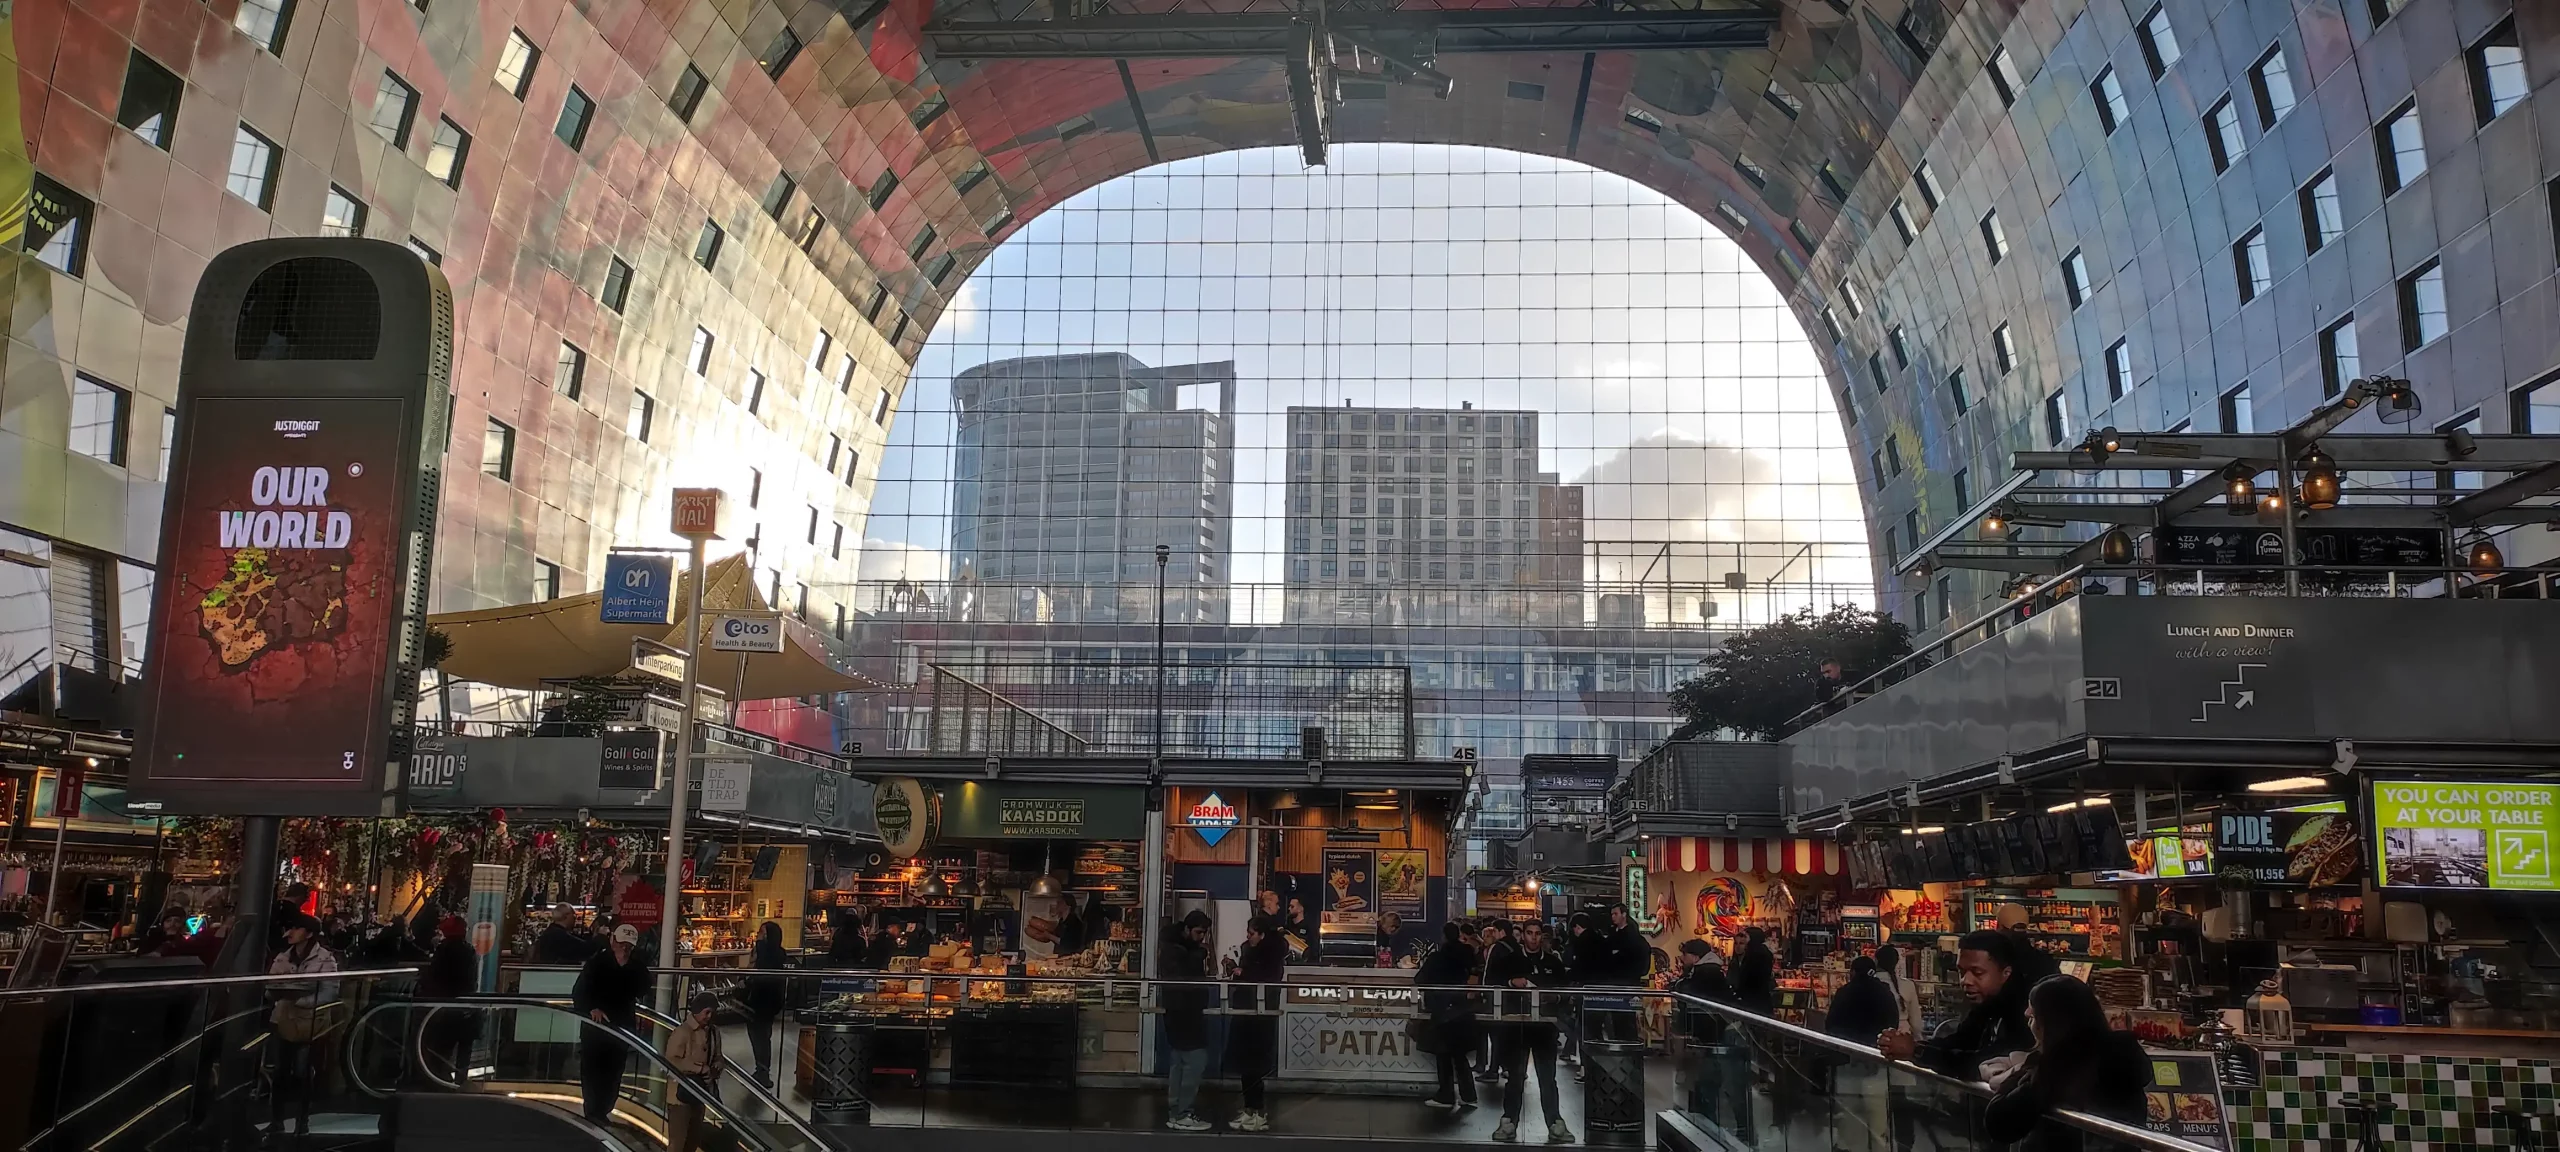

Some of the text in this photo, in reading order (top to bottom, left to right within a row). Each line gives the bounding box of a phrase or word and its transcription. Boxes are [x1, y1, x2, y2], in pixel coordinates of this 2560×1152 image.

[274, 420, 320, 431] JUSTDIGGIT
[252, 466, 328, 506] OUR
[220, 511, 352, 549] WORLD
[2262, 538, 2279, 547] Bab
[2260, 545, 2282, 555] Tuma
[607, 597, 664, 608] Albert Heijn
[607, 609, 662, 619] Supermarkt
[725, 619, 769, 638] etos
[749, 641, 774, 649] Beauty
[2176, 639, 2275, 659] with a view!
[2085, 680, 2118, 697] 20
[604, 747, 627, 760] Gall
[632, 747, 655, 760] Gall
[842, 742, 862, 755] 48
[1454, 748, 1475, 759] 46
[409, 754, 467, 785] ARIO'S
[632, 764, 653, 772] Spirits
[709, 769, 725, 779] DE
[688, 781, 702, 790] 70
[708, 780, 736, 790] TIJD
[707, 790, 740, 800] TRAP
[2384, 788, 2553, 806] YOU CAN ORDER
[1003, 801, 1062, 809] CROMWIJK
[1632, 801, 1647, 810] 16
[1002, 810, 1081, 823] KAASDOK
[1193, 805, 1233, 818] BRAM
[2396, 808, 2544, 825] AT YOUR TABLE
[1003, 826, 1080, 835] WWW.KAASDOK.NL
[2221, 815, 2273, 846] PIDE
[2254, 868, 2285, 881] 11,95€
[2146, 1122, 2219, 1133] RAPS MENU'S
